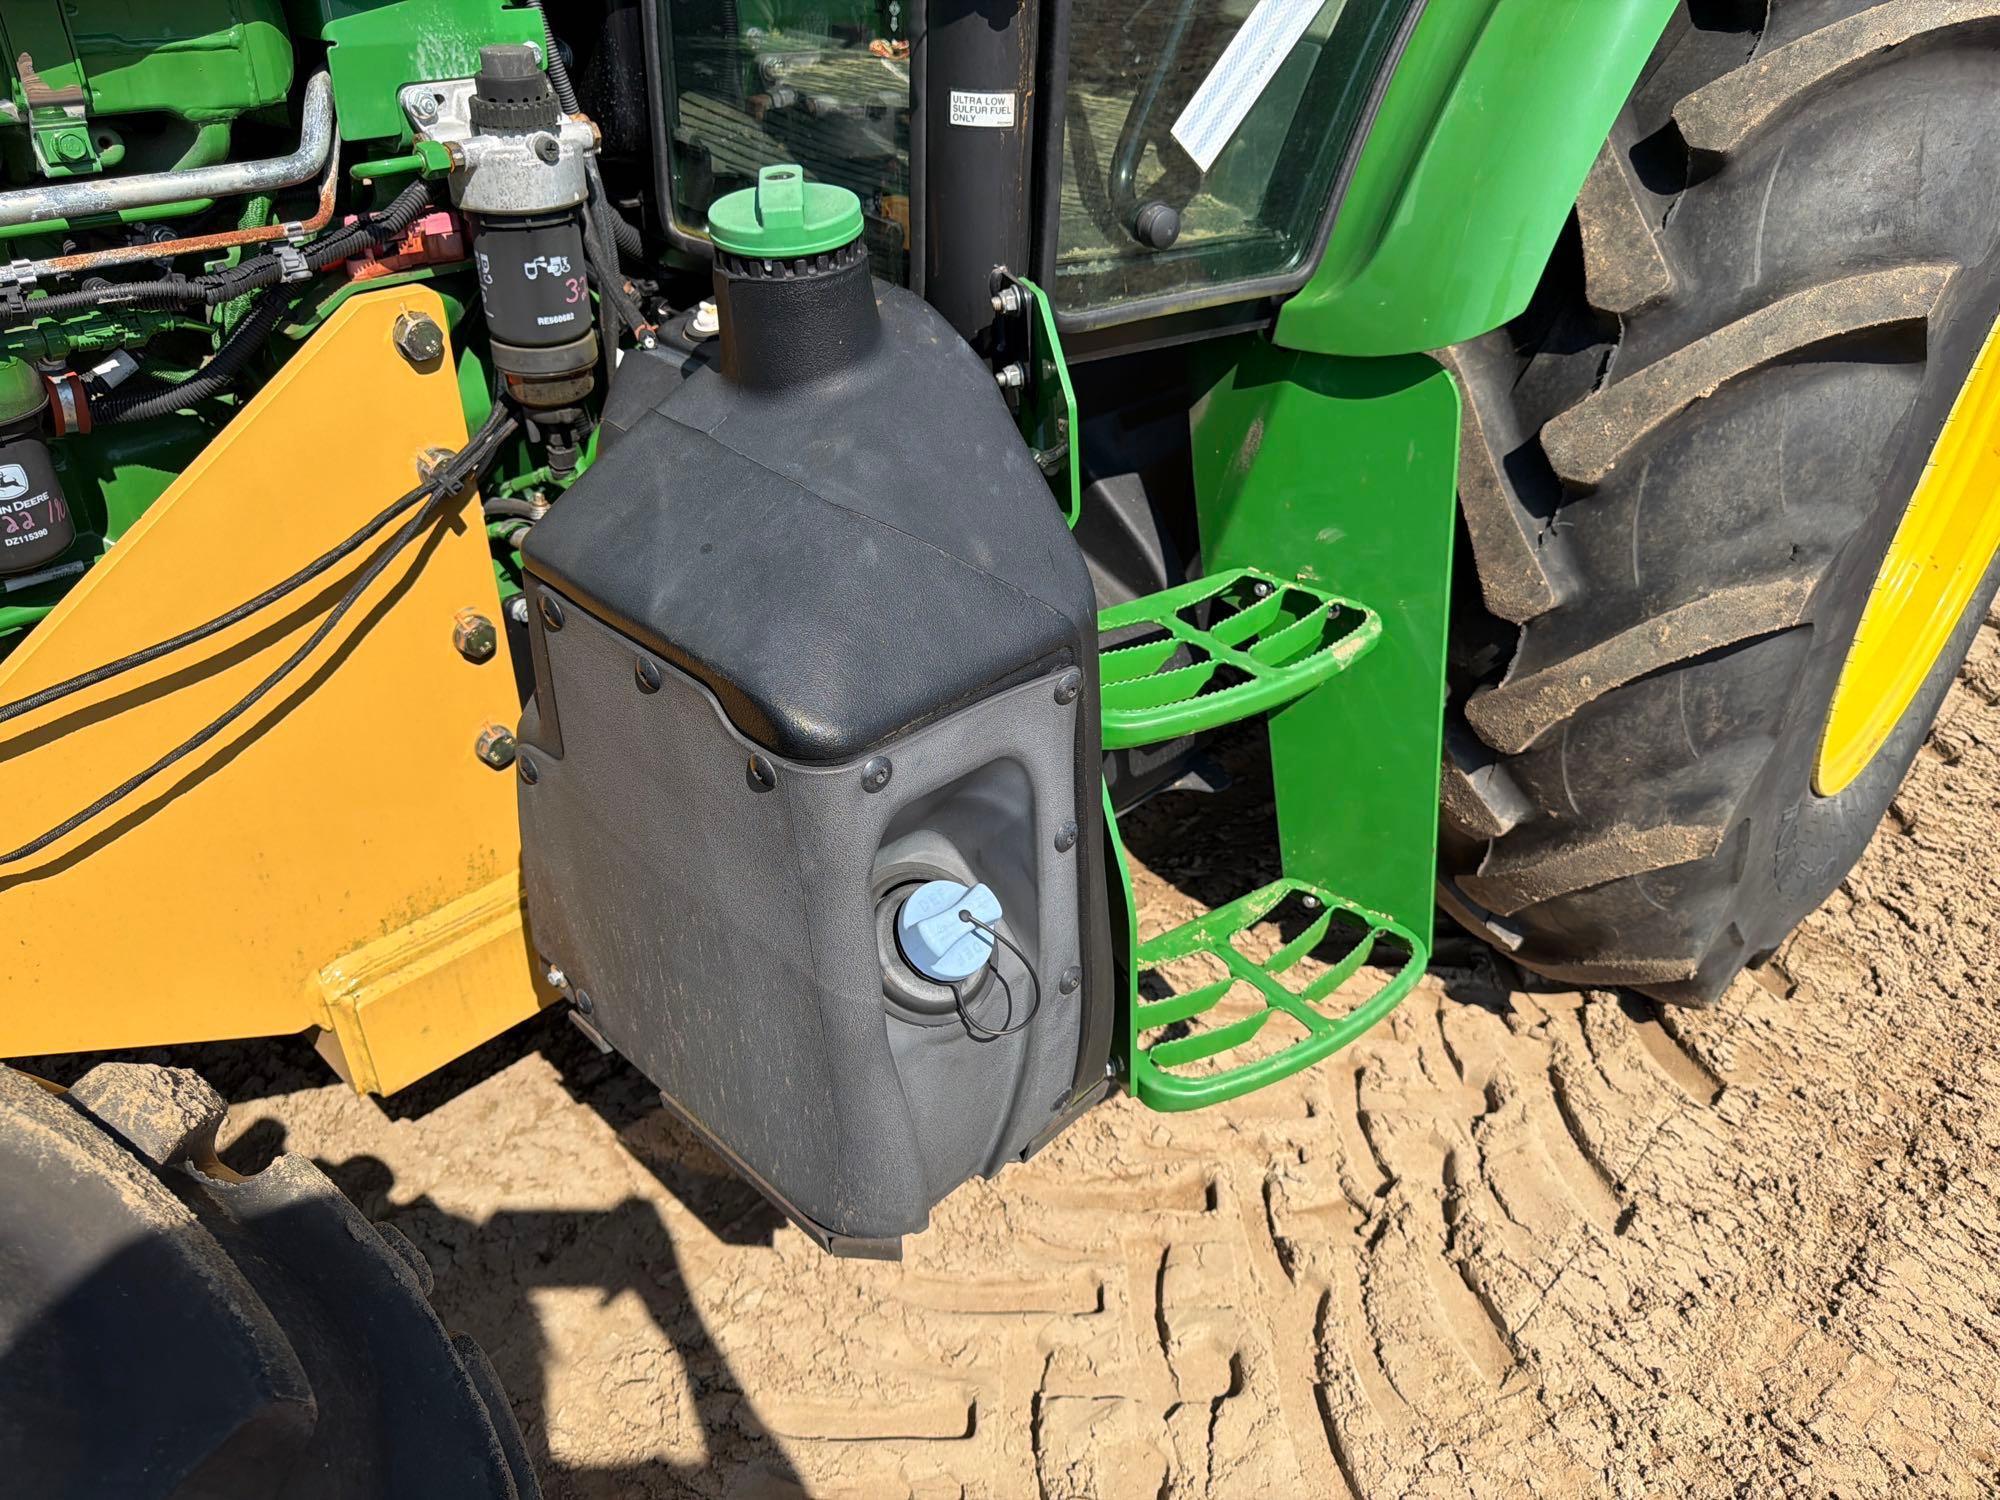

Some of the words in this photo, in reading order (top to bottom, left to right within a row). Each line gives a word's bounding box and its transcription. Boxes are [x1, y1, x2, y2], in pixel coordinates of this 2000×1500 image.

[953, 95, 983, 105] ULTRA
[985, 97, 1006, 106] LOW
[953, 104, 988, 114] SULFUR
[990, 106, 1012, 115] FUEL
[953, 113, 976, 123] ONLY
[13, 491, 50, 512] DEERE
[5, 528, 49, 547] DZ115390
